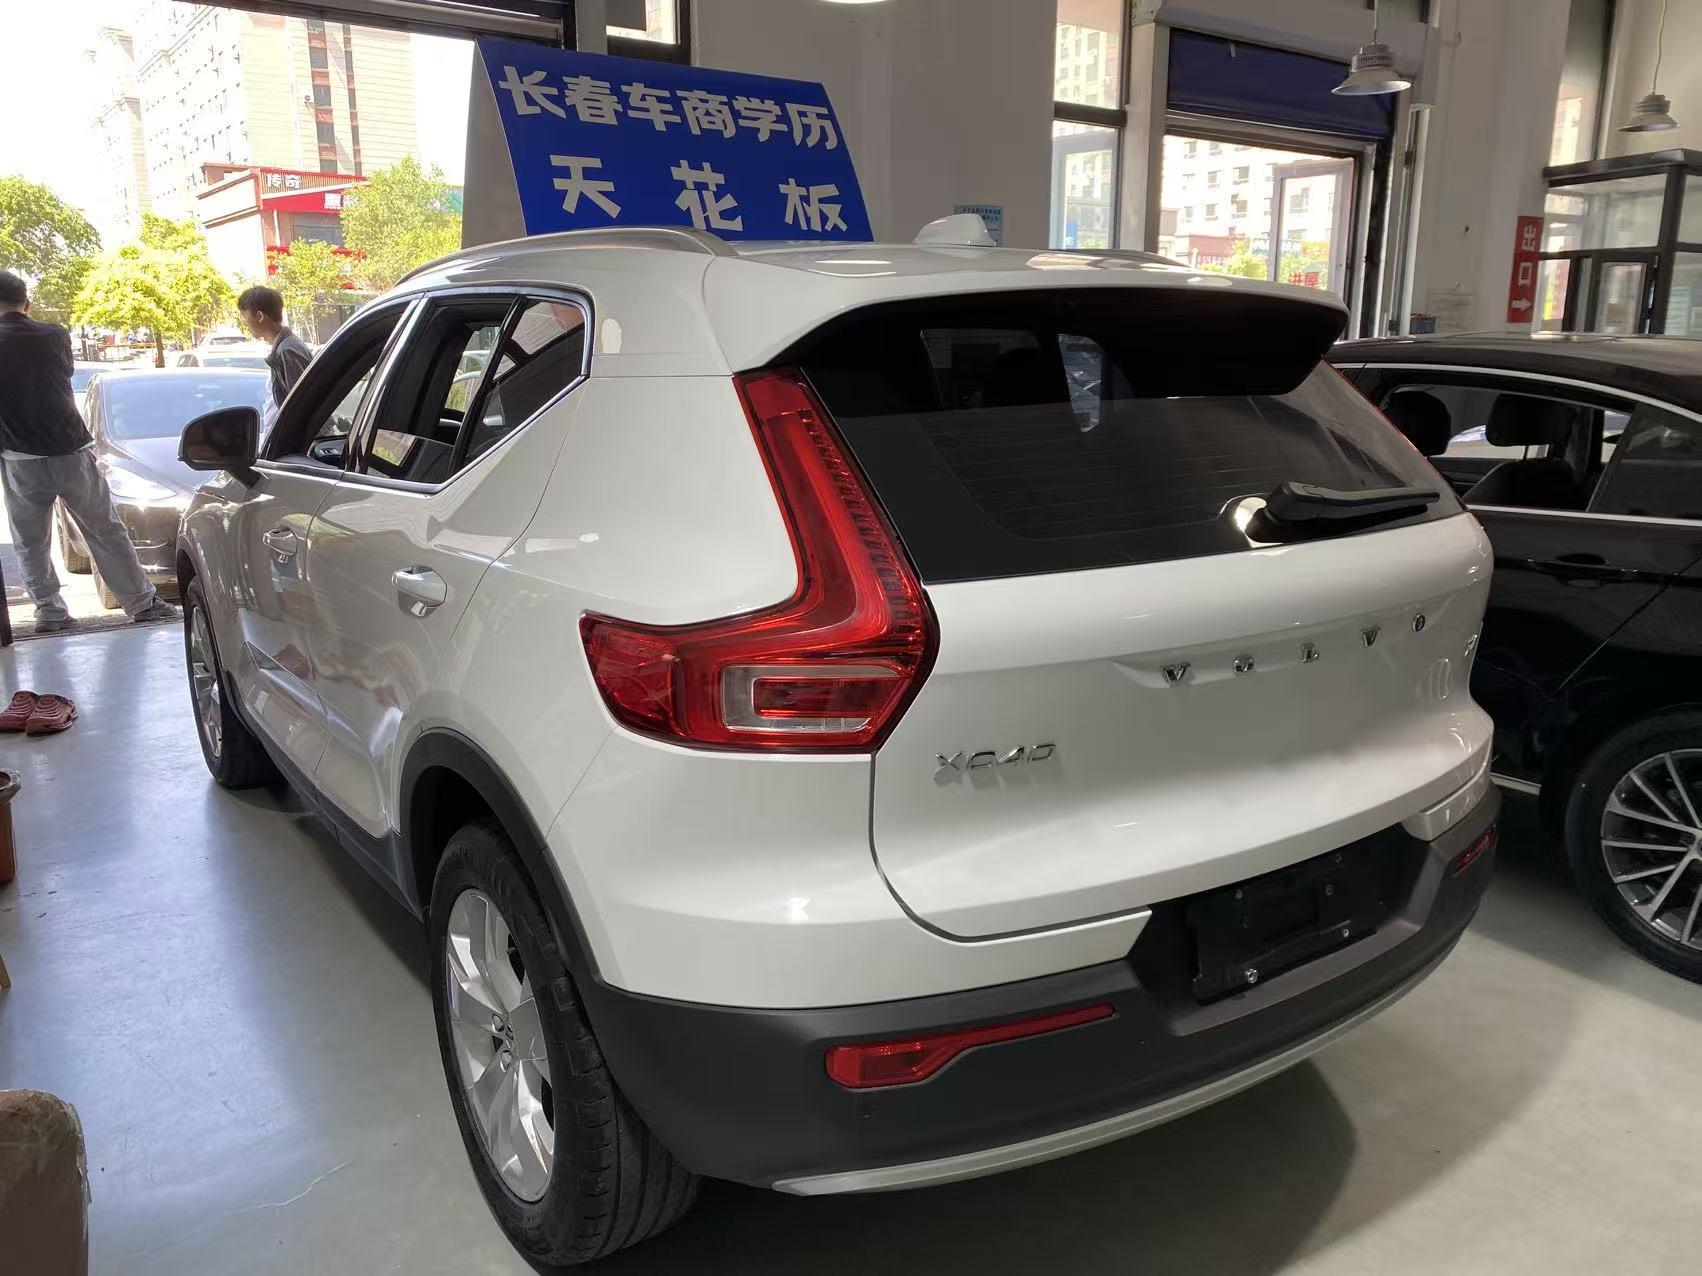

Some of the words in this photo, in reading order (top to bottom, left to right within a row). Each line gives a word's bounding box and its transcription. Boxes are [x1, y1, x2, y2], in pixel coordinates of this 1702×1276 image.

[499, 65, 838, 150] 长春车商学历
[549, 154, 848, 232] 天花板
[1518, 224, 1537, 286] 出口
[1160, 613, 1427, 685] VOLVO
[934, 743, 1057, 772] XC40
